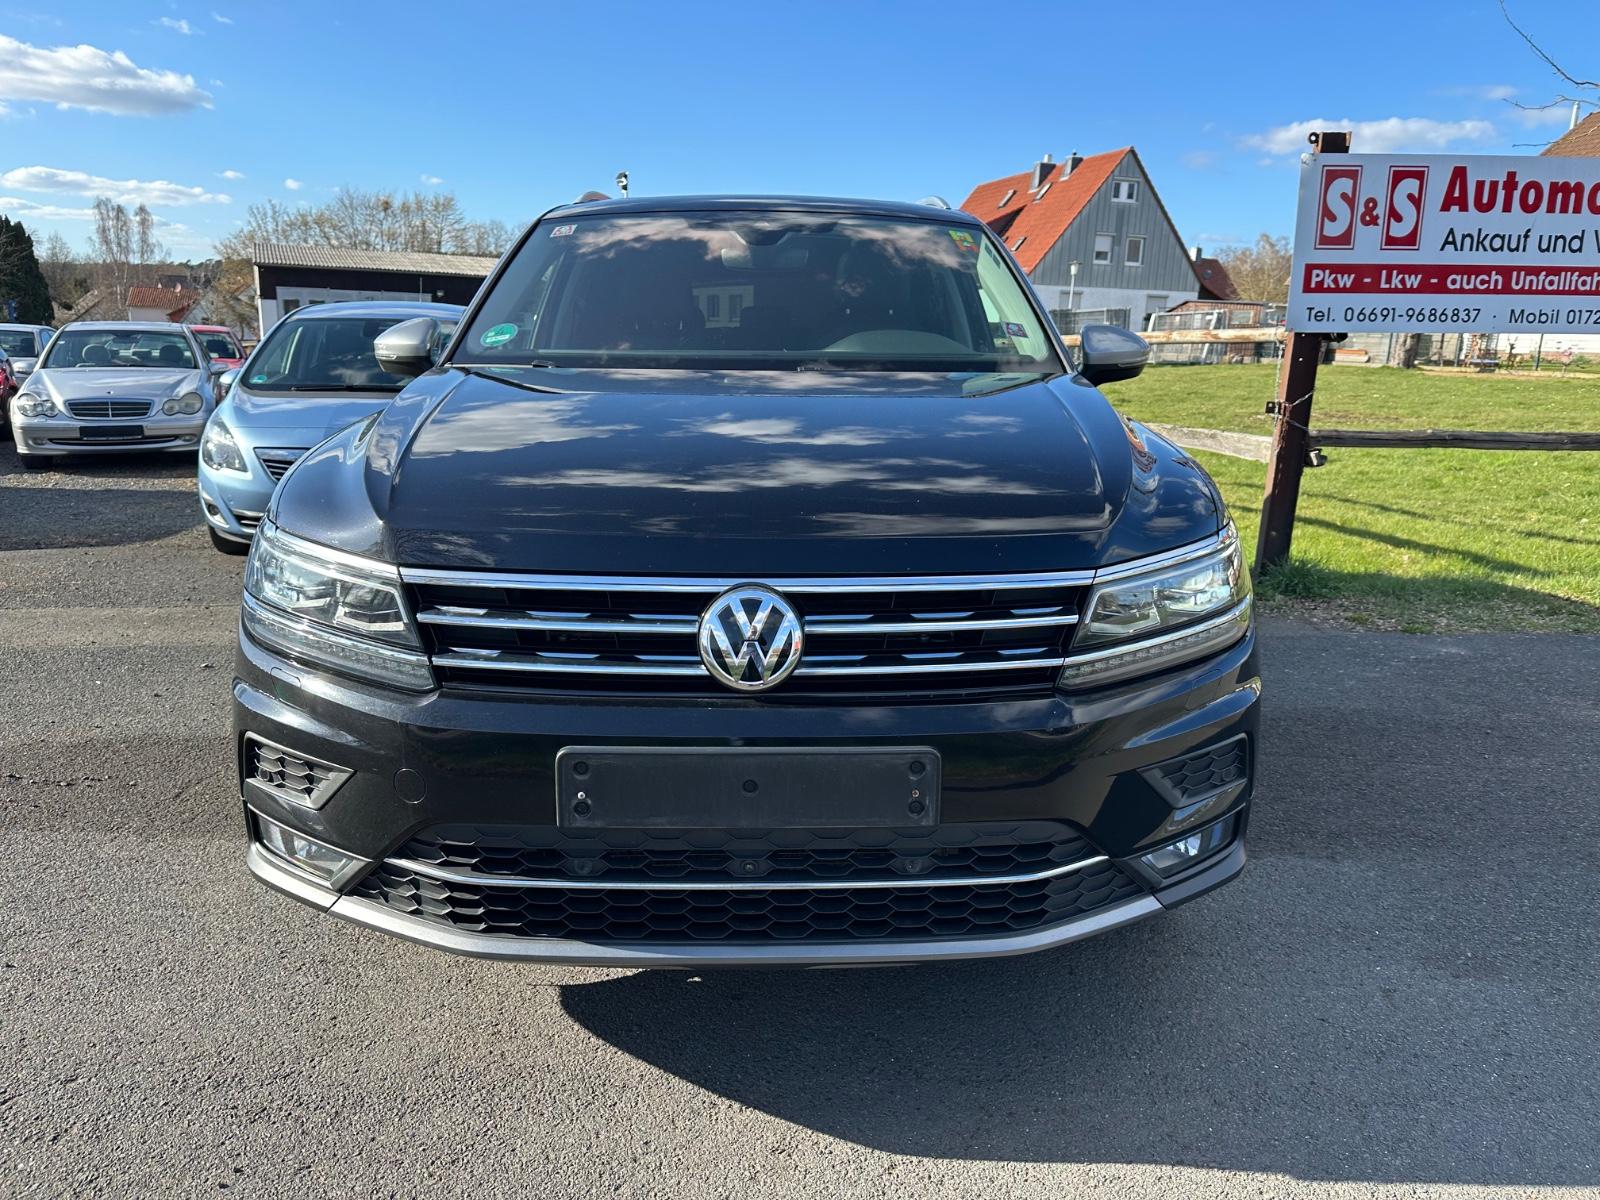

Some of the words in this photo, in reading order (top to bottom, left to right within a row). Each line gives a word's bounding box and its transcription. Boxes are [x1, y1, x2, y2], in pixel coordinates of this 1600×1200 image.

[1440, 228, 1531, 253] Ankauf
[1537, 229, 1585, 254] und
[1310, 270, 1355, 289] Pkw
[1380, 271, 1422, 289] Lkw
[1447, 272, 1503, 290] auch
[1306, 307, 1335, 322] Tel.
[1344, 307, 1481, 323] 06691-9686837
[1508, 309, 1560, 324] Mobil
[704, 589, 798, 687] VW
